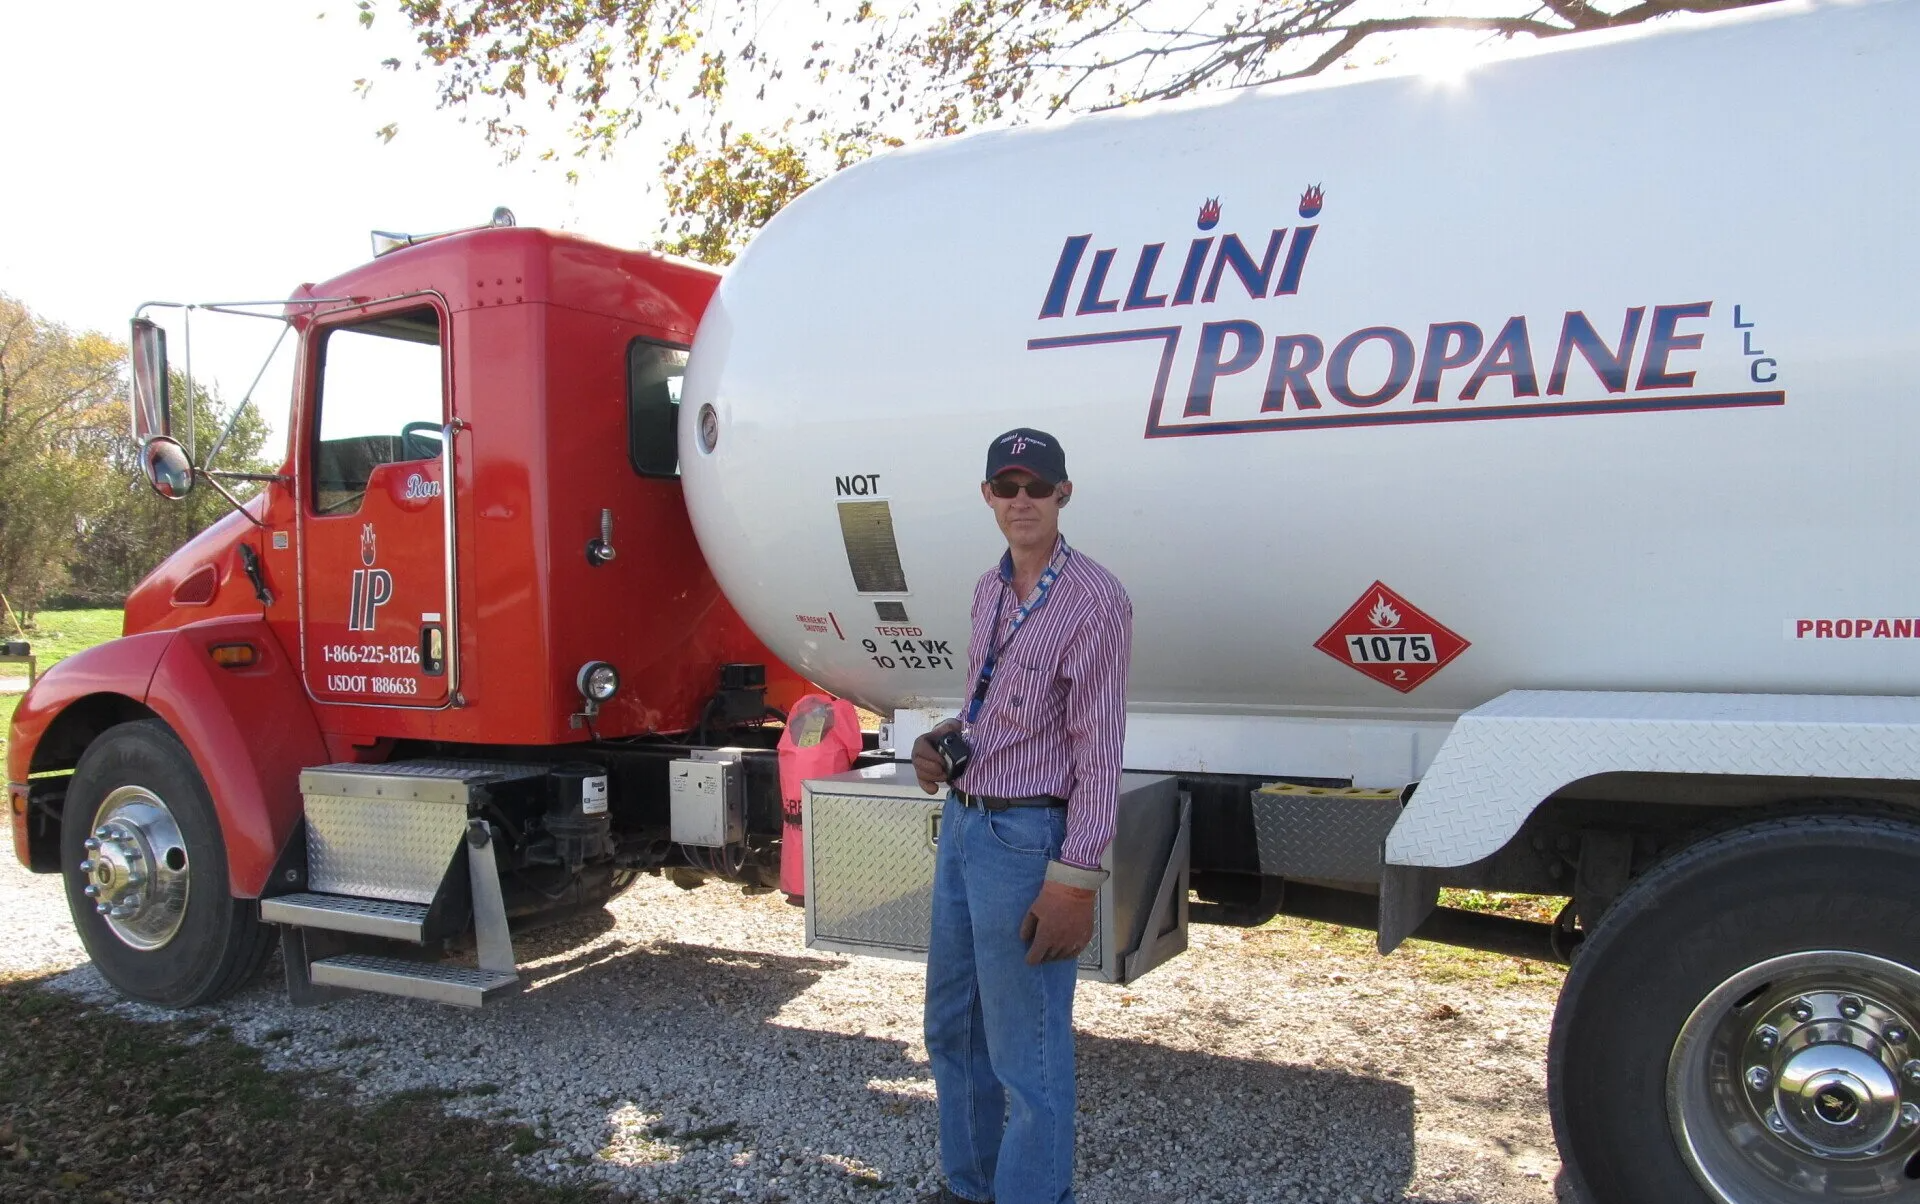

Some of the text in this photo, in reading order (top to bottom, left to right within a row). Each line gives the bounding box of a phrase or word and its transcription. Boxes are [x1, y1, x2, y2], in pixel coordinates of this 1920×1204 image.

[1038, 222, 1320, 320] ILLINI
[1183, 299, 1713, 418] PROPANE
[1011, 442, 1026, 454] IP
[406, 473, 441, 499] Ron
[835, 474, 880, 496] NQT
[349, 568, 393, 631] IP
[875, 626, 923, 637] TESTED
[323, 645, 420, 664] 1-866-225-8126
[862, 639, 877, 653] 9
[890, 639, 916, 653] 14
[1351, 636, 1431, 662] 1075
[871, 655, 896, 669] 10
[899, 656, 926, 669] 12
[327, 674, 417, 694] USDOT 1886633
[1392, 669, 1408, 681] 2
